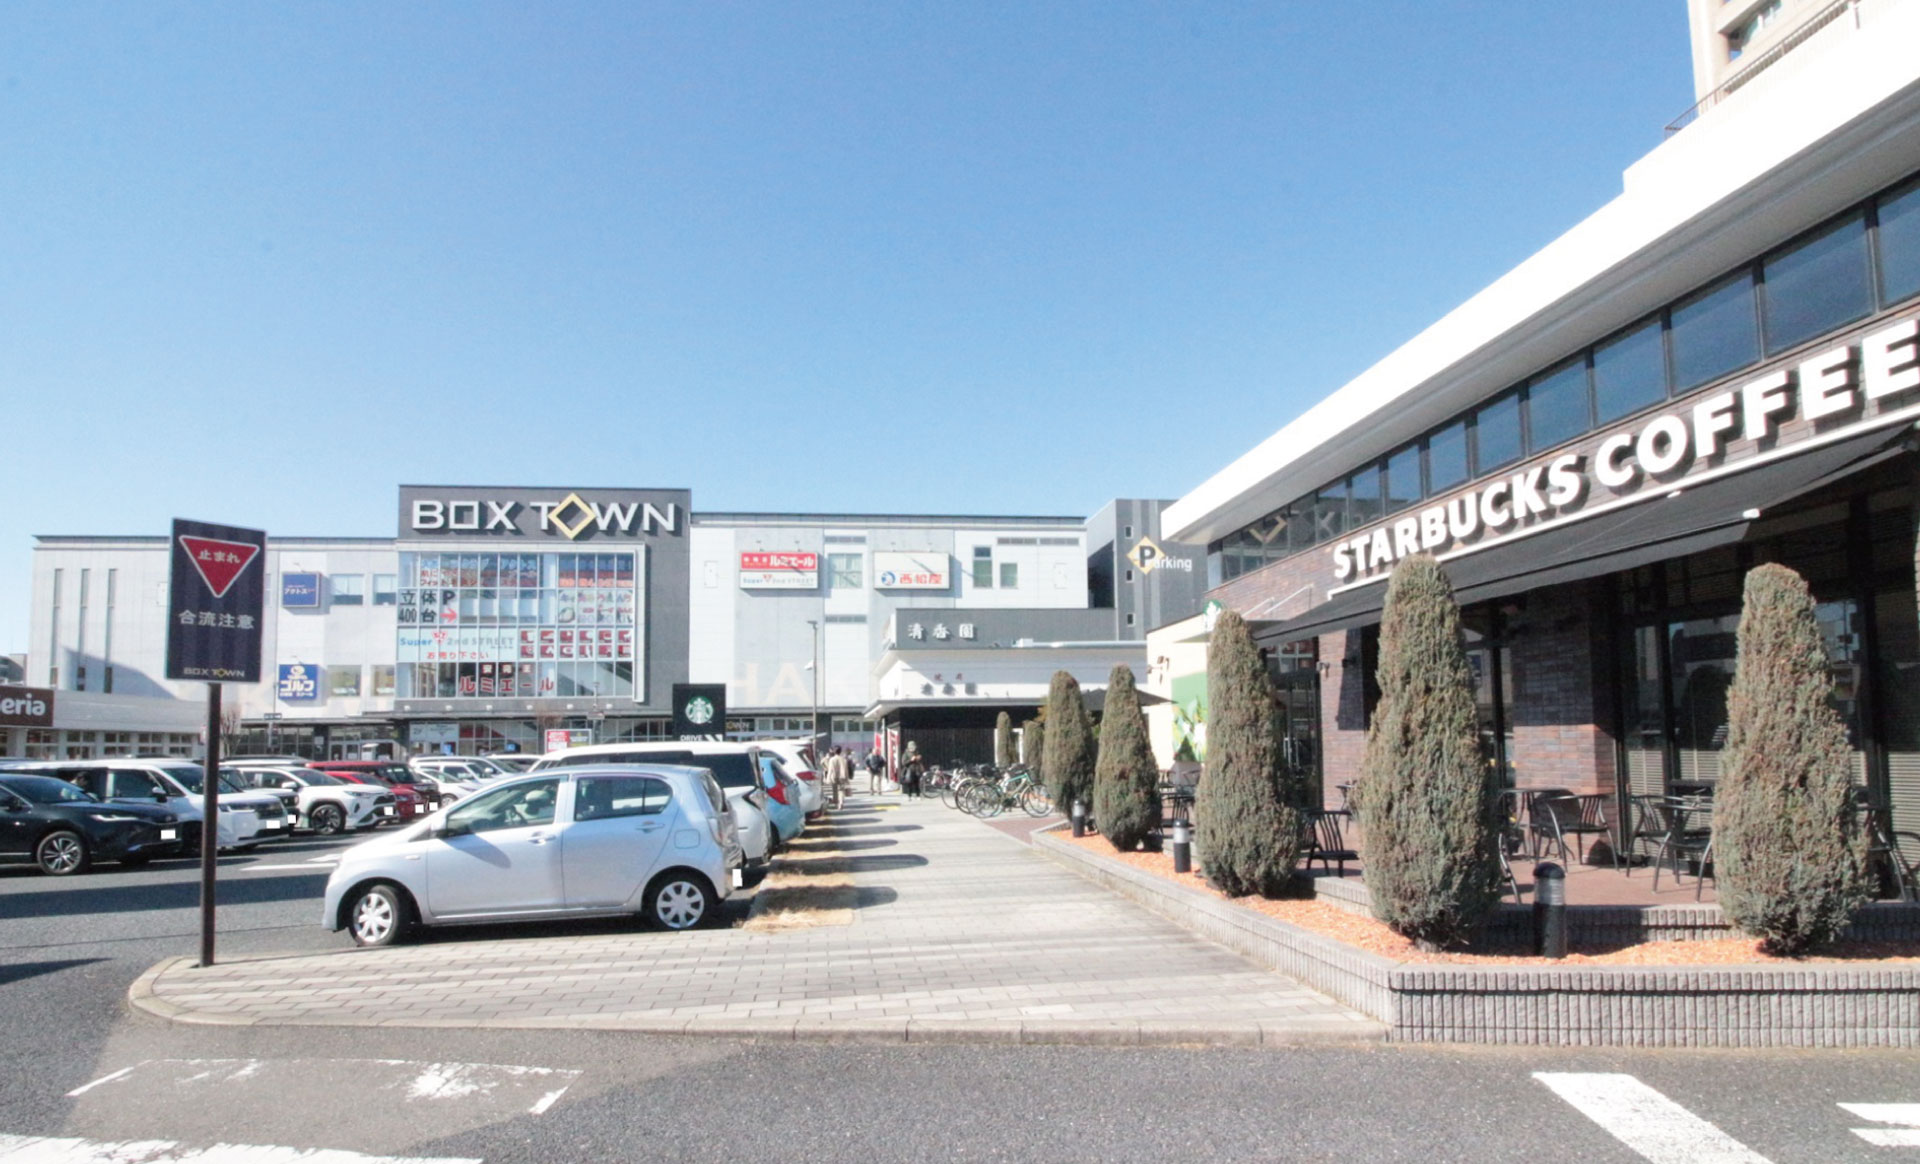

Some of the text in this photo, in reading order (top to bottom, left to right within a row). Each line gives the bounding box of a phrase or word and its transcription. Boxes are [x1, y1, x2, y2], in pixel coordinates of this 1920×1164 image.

[1334, 319, 1920, 578] STARBUCKS COFFEE
[412, 492, 675, 540] BOX TOWN
[197, 549, 241, 564] 止まれ
[770, 555, 814, 567] ルミエール
[1139, 545, 1193, 572] Parking
[899, 573, 942, 584] 西松屋
[178, 609, 255, 629] 合流注意
[399, 637, 514, 647] Super 2nd STREET
[183, 667, 245, 678] BOX TOWN
[280, 680, 315, 692] ゴルフ
[460, 676, 554, 692] ルミエール
[0, 692, 46, 716] eria
